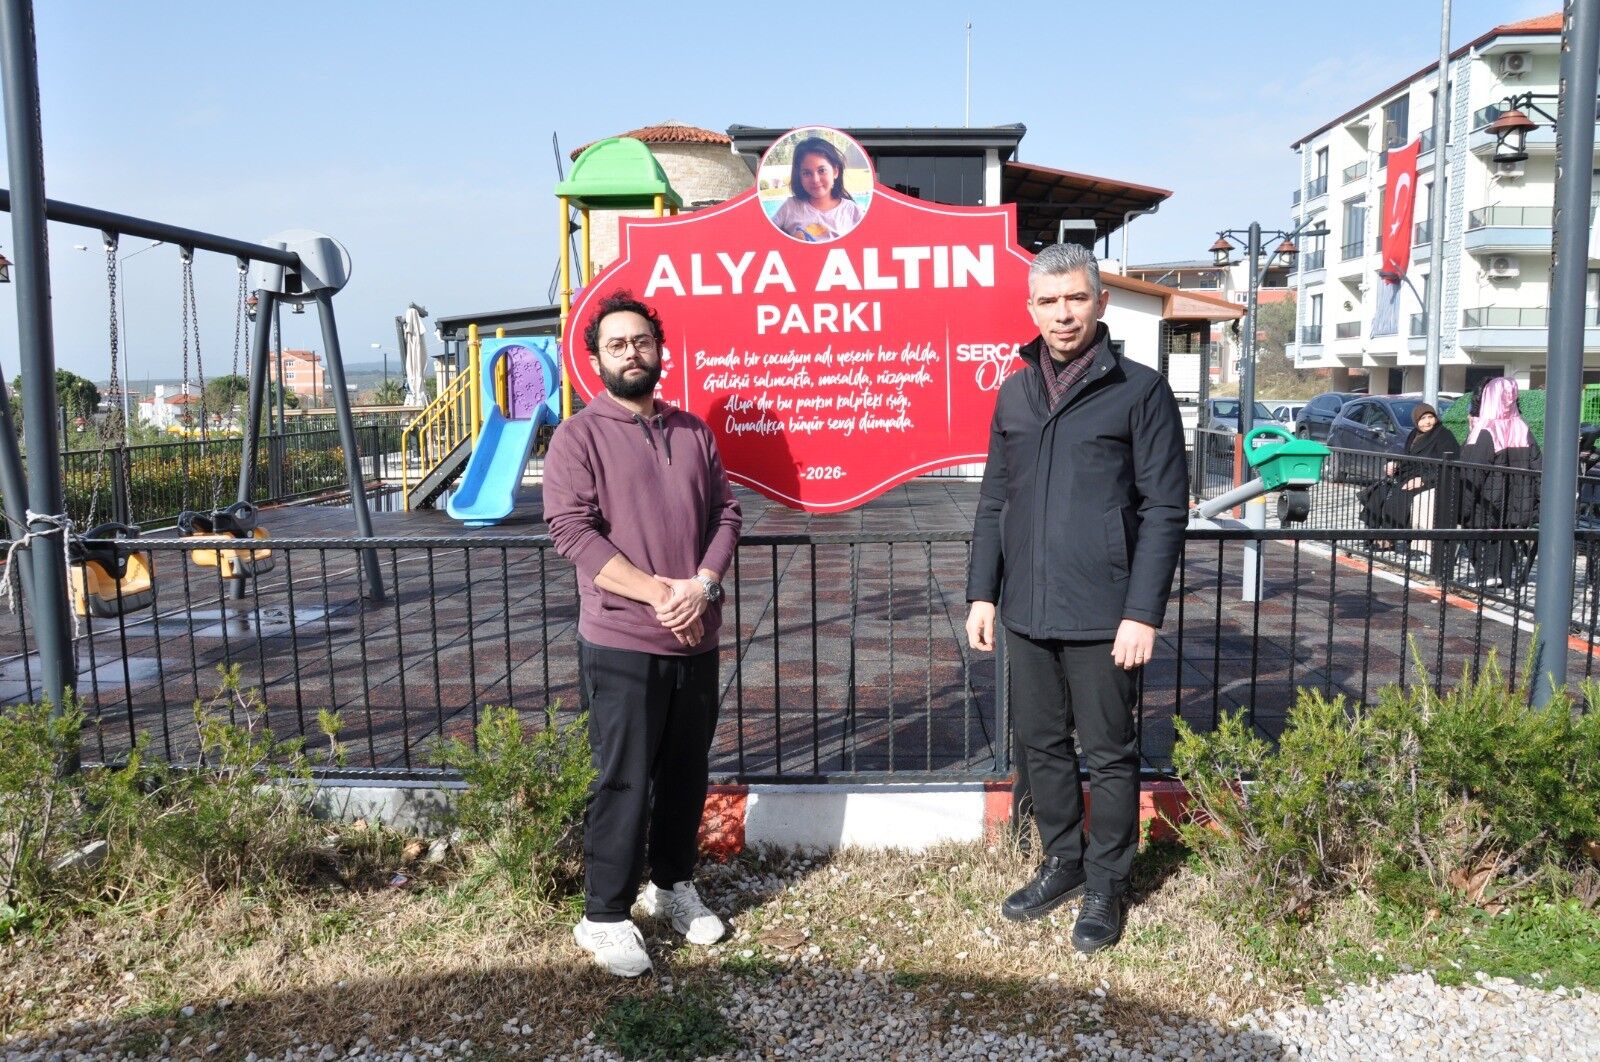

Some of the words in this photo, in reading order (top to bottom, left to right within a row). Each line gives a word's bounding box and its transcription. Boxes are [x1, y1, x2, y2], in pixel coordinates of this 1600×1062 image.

[643, 249, 797, 298] ALYA
[814, 244, 995, 292] ALTIN
[756, 302, 882, 336] PARKI
[695, 347, 740, 370] Burada
[744, 350, 761, 368] bir
[763, 349, 811, 371] çocuğun
[814, 344, 833, 368] adı
[837, 349, 875, 367] yeşerir
[877, 344, 899, 362] her
[901, 342, 940, 366] dalda,
[956, 343, 1029, 361] SERCA
[703, 372, 749, 393] Gülüşü
[753, 366, 815, 389] salıncakta,
[818, 366, 872, 389] masalda,
[876, 364, 933, 390] rüzgarda.
[776, 394, 792, 411] bu
[795, 395, 833, 414] parkın
[836, 386, 883, 412] kalpteki
[725, 414, 785, 437] Oynadıkça
[789, 415, 825, 435] büyür
[827, 416, 855, 437] sevgi
[858, 409, 914, 434] dünyada.
[800, 466, 847, 480] -2026-
